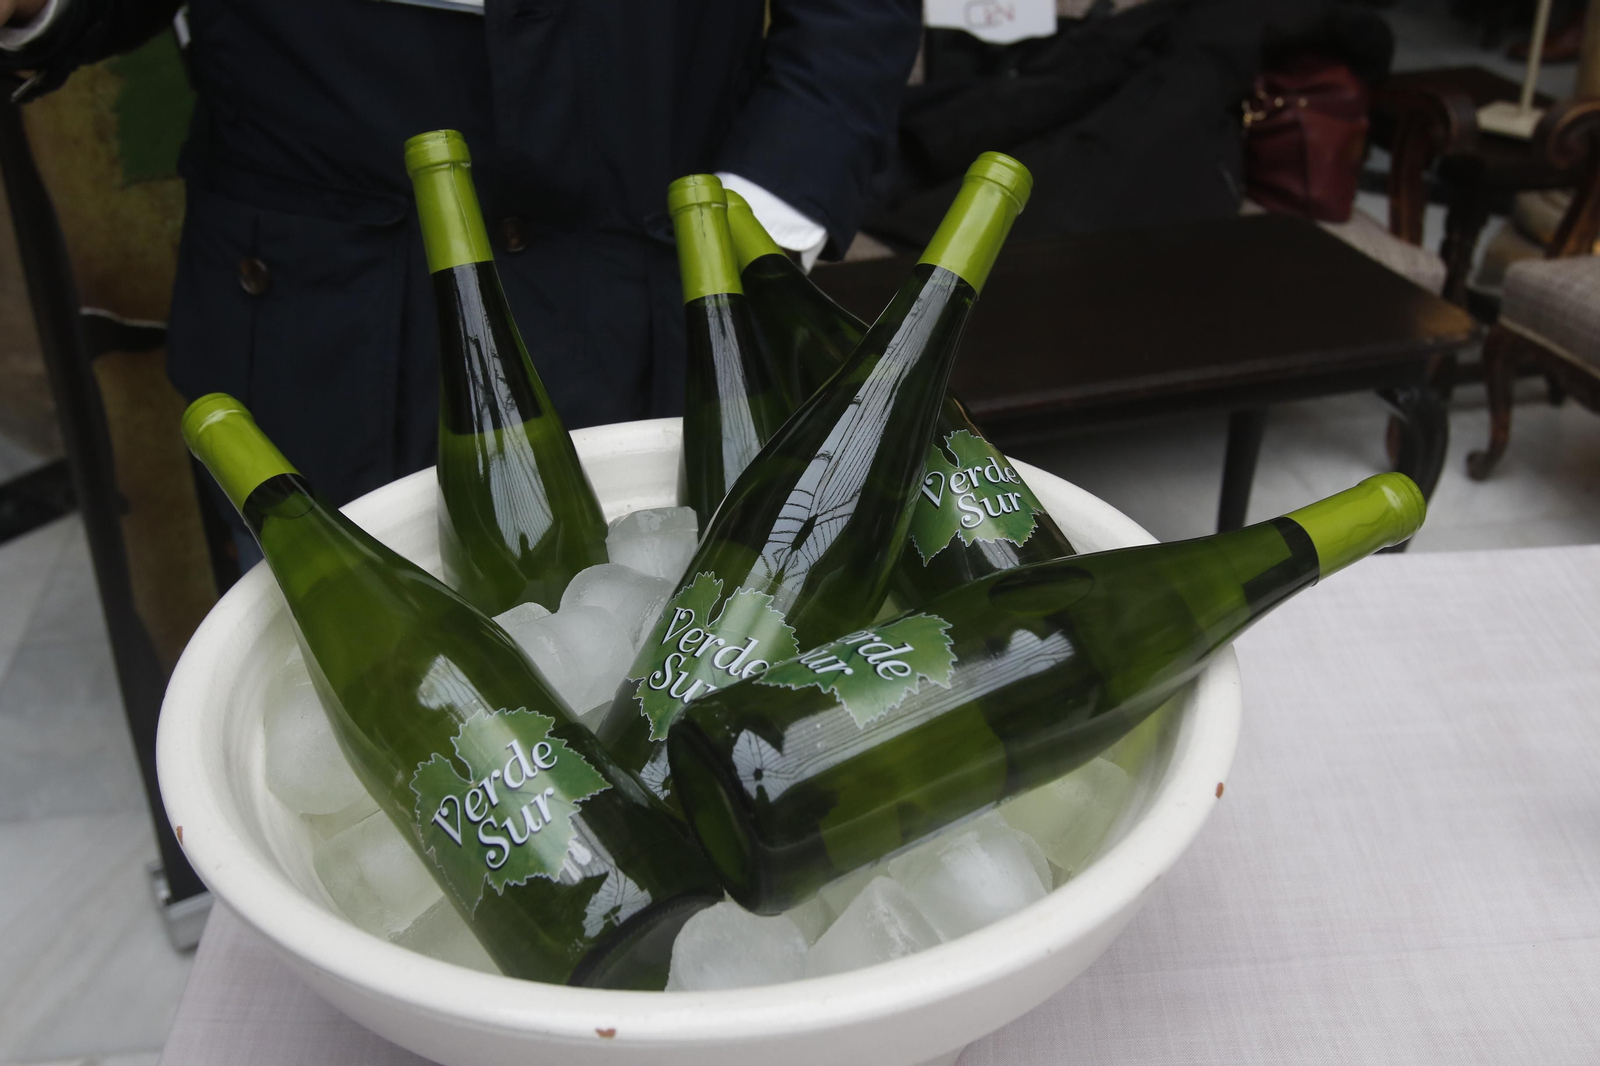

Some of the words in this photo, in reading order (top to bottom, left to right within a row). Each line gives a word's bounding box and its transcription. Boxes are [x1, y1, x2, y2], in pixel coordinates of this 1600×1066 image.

[922, 457, 1020, 508] Verde
[957, 491, 1021, 528] Sur
[661, 606, 769, 679] Verde
[798, 642, 854, 674] ur
[431, 739, 558, 847] Verde
[477, 786, 555, 869] Sur
